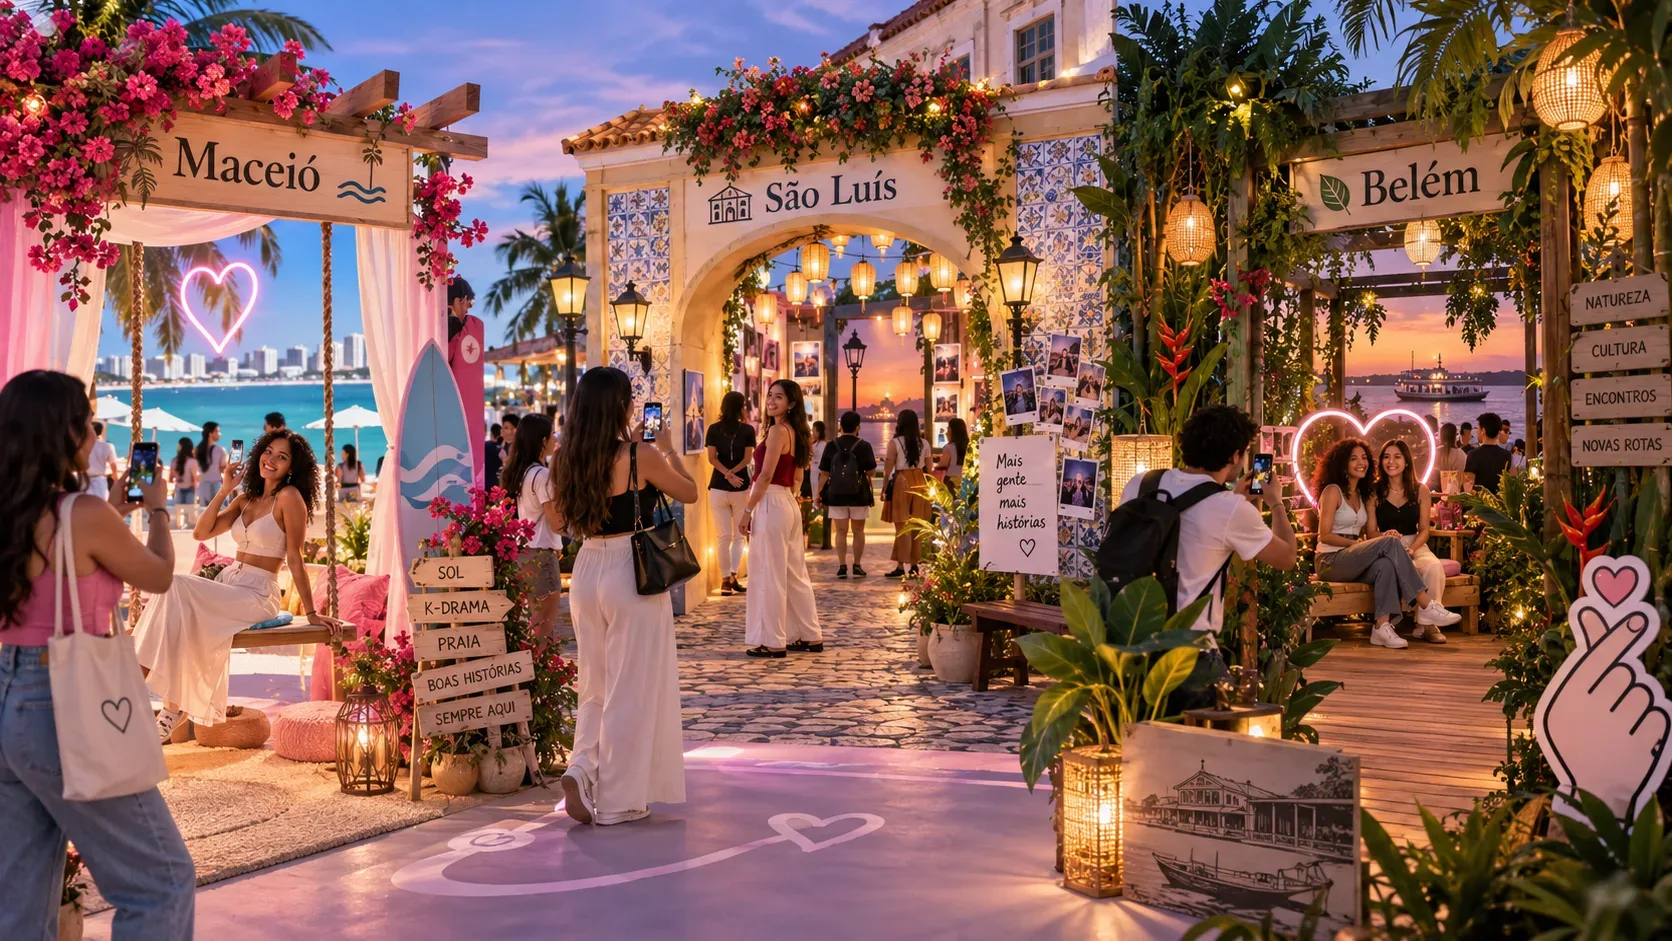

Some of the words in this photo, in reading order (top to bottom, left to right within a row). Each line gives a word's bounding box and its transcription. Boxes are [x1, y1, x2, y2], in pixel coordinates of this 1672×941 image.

[173, 136, 320, 192] Maceió
[766, 180, 820, 213] São
[831, 169, 897, 206] Luís
[1361, 160, 1481, 207] Belém
[1585, 289, 1651, 310] NATUREZA
[1591, 340, 1647, 358] CULTURA
[1585, 389, 1657, 406] ENCONTROS
[1582, 438, 1620, 452] NOVAS
[1624, 437, 1663, 451] ROTAS
[996, 453, 1023, 469] Mais
[996, 471, 1027, 493] gente
[999, 494, 1026, 509] mais
[996, 514, 1046, 530] histórias
[438, 565, 464, 580] SOL
[424, 600, 490, 616] K-DRAMA
[437, 634, 481, 651] PRAIA
[427, 674, 459, 692] BOAS
[463, 661, 522, 685] HISTÓRIAS
[435, 706, 483, 726] SEMPRE
[487, 700, 516, 718] AQUI
